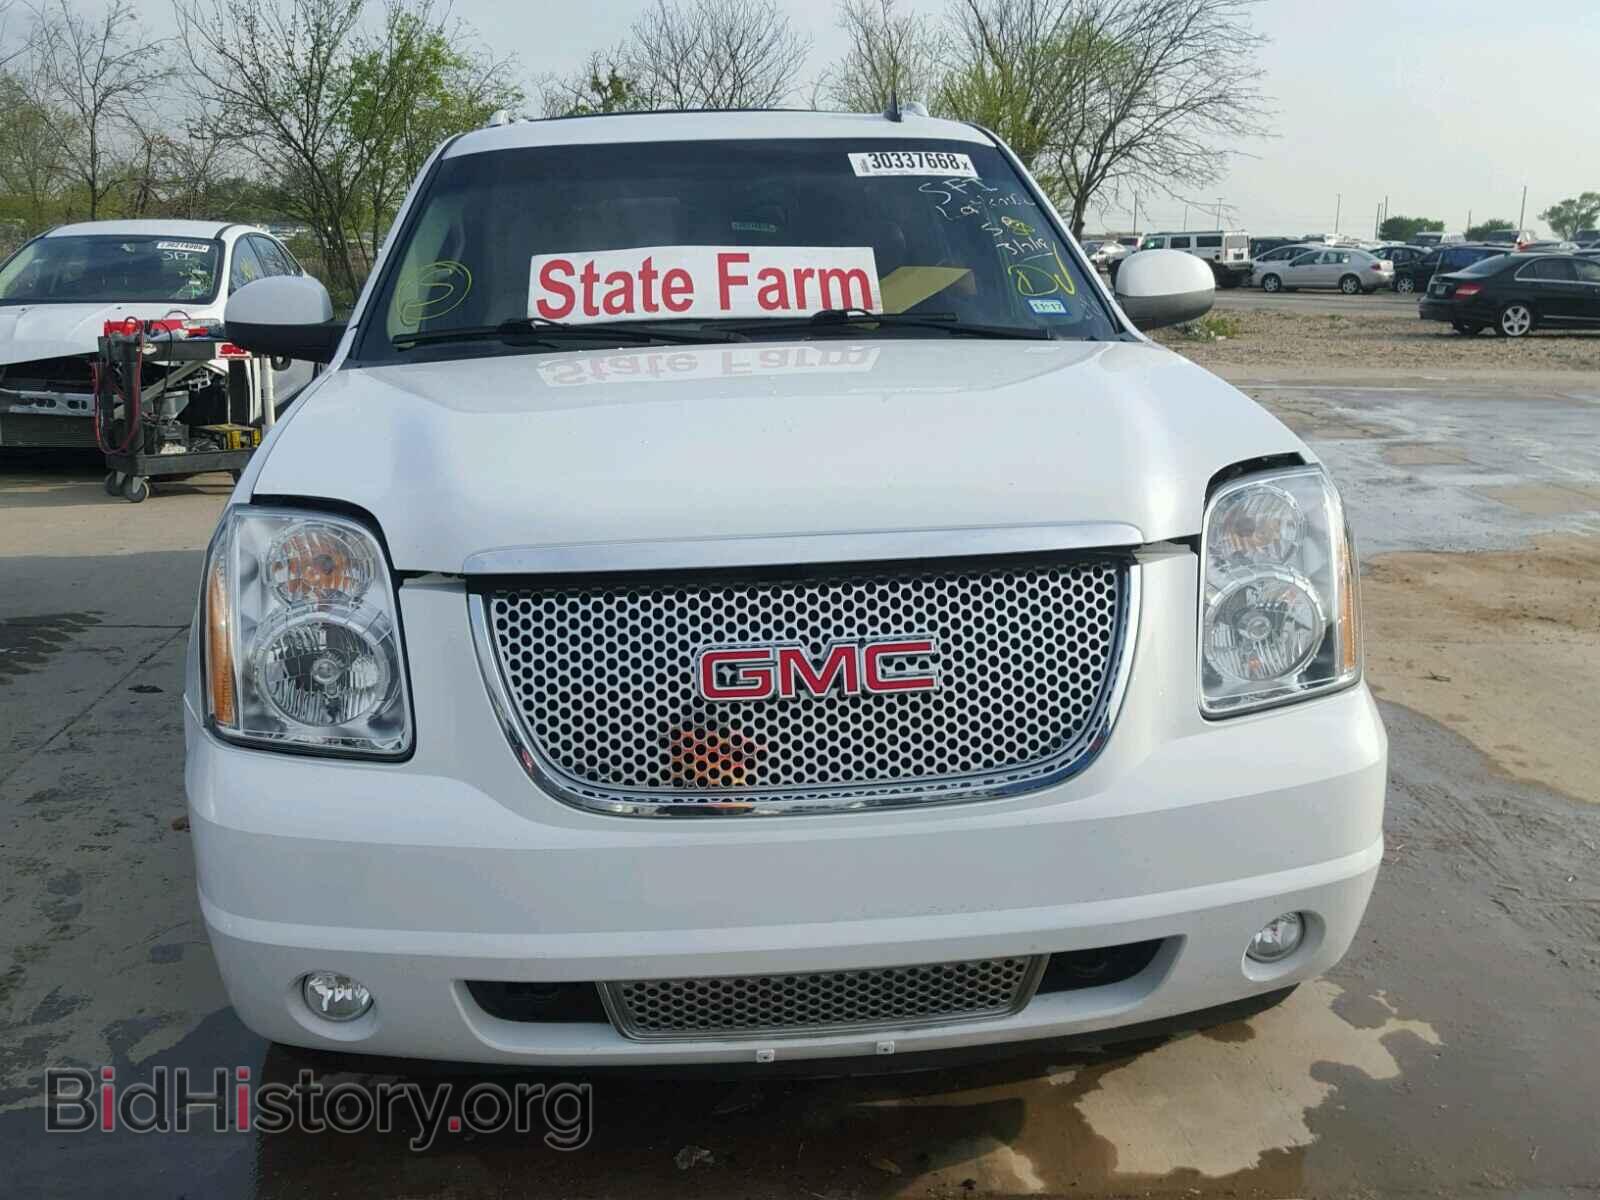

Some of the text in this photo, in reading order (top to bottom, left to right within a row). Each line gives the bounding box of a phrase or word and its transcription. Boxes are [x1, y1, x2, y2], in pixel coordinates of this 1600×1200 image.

[868, 152, 960, 170] 30337668
[536, 251, 874, 319] State Farm
[699, 638, 940, 701] GMC
